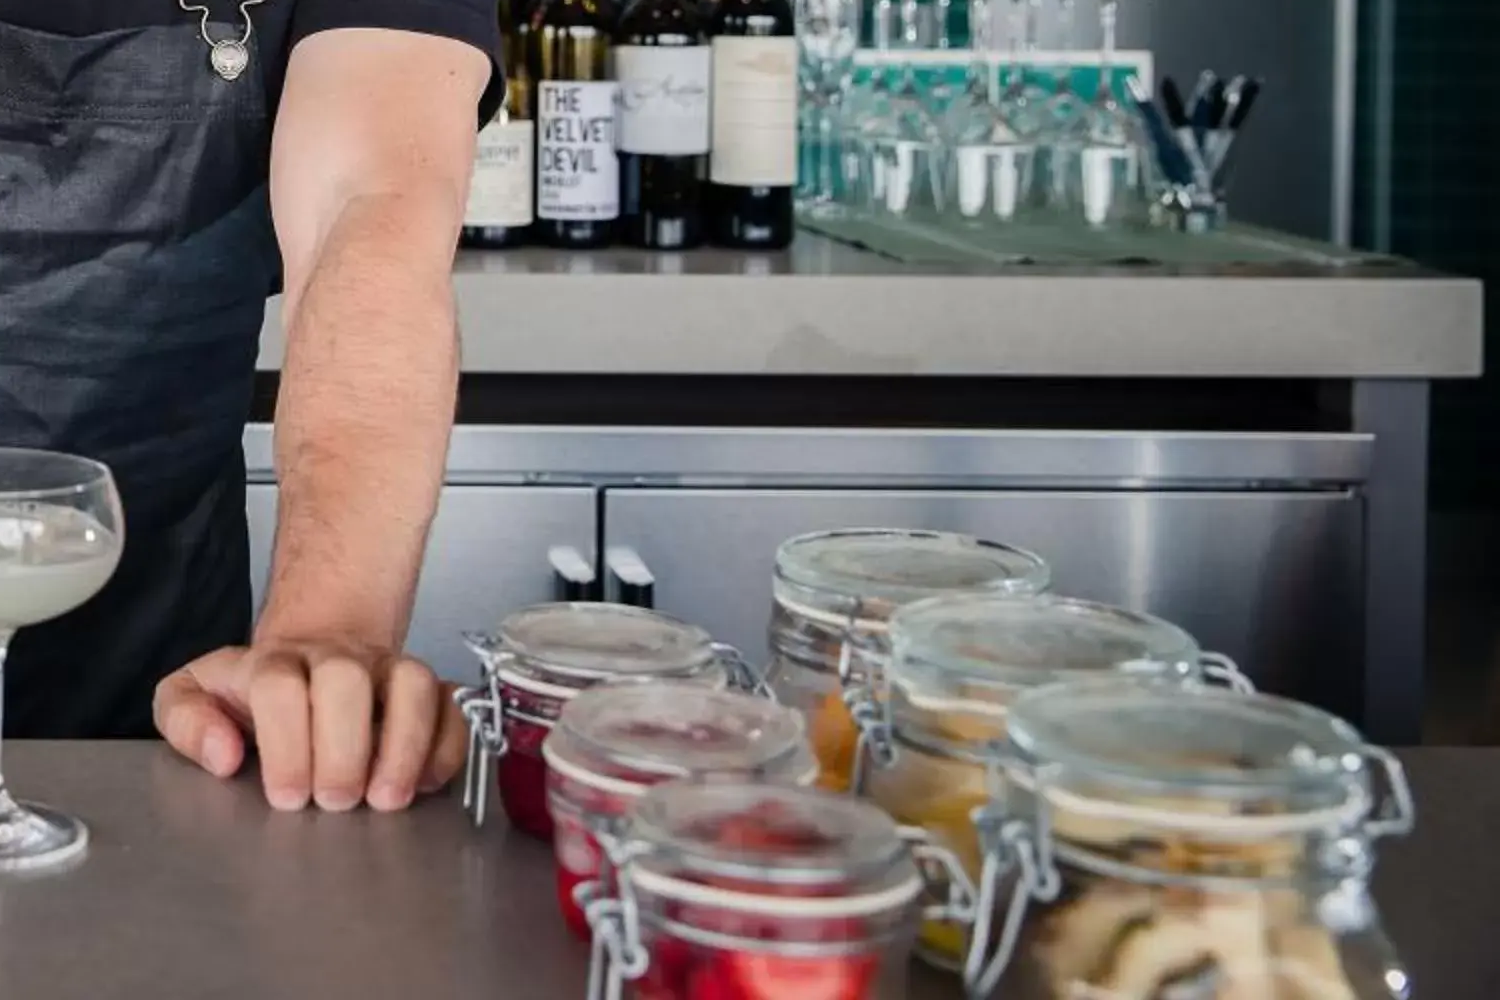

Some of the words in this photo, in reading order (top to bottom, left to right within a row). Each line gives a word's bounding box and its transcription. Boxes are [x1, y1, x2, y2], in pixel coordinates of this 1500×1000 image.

[543, 86, 582, 113] THE
[541, 116, 613, 143] VELVET
[540, 145, 599, 174] DEVIL
